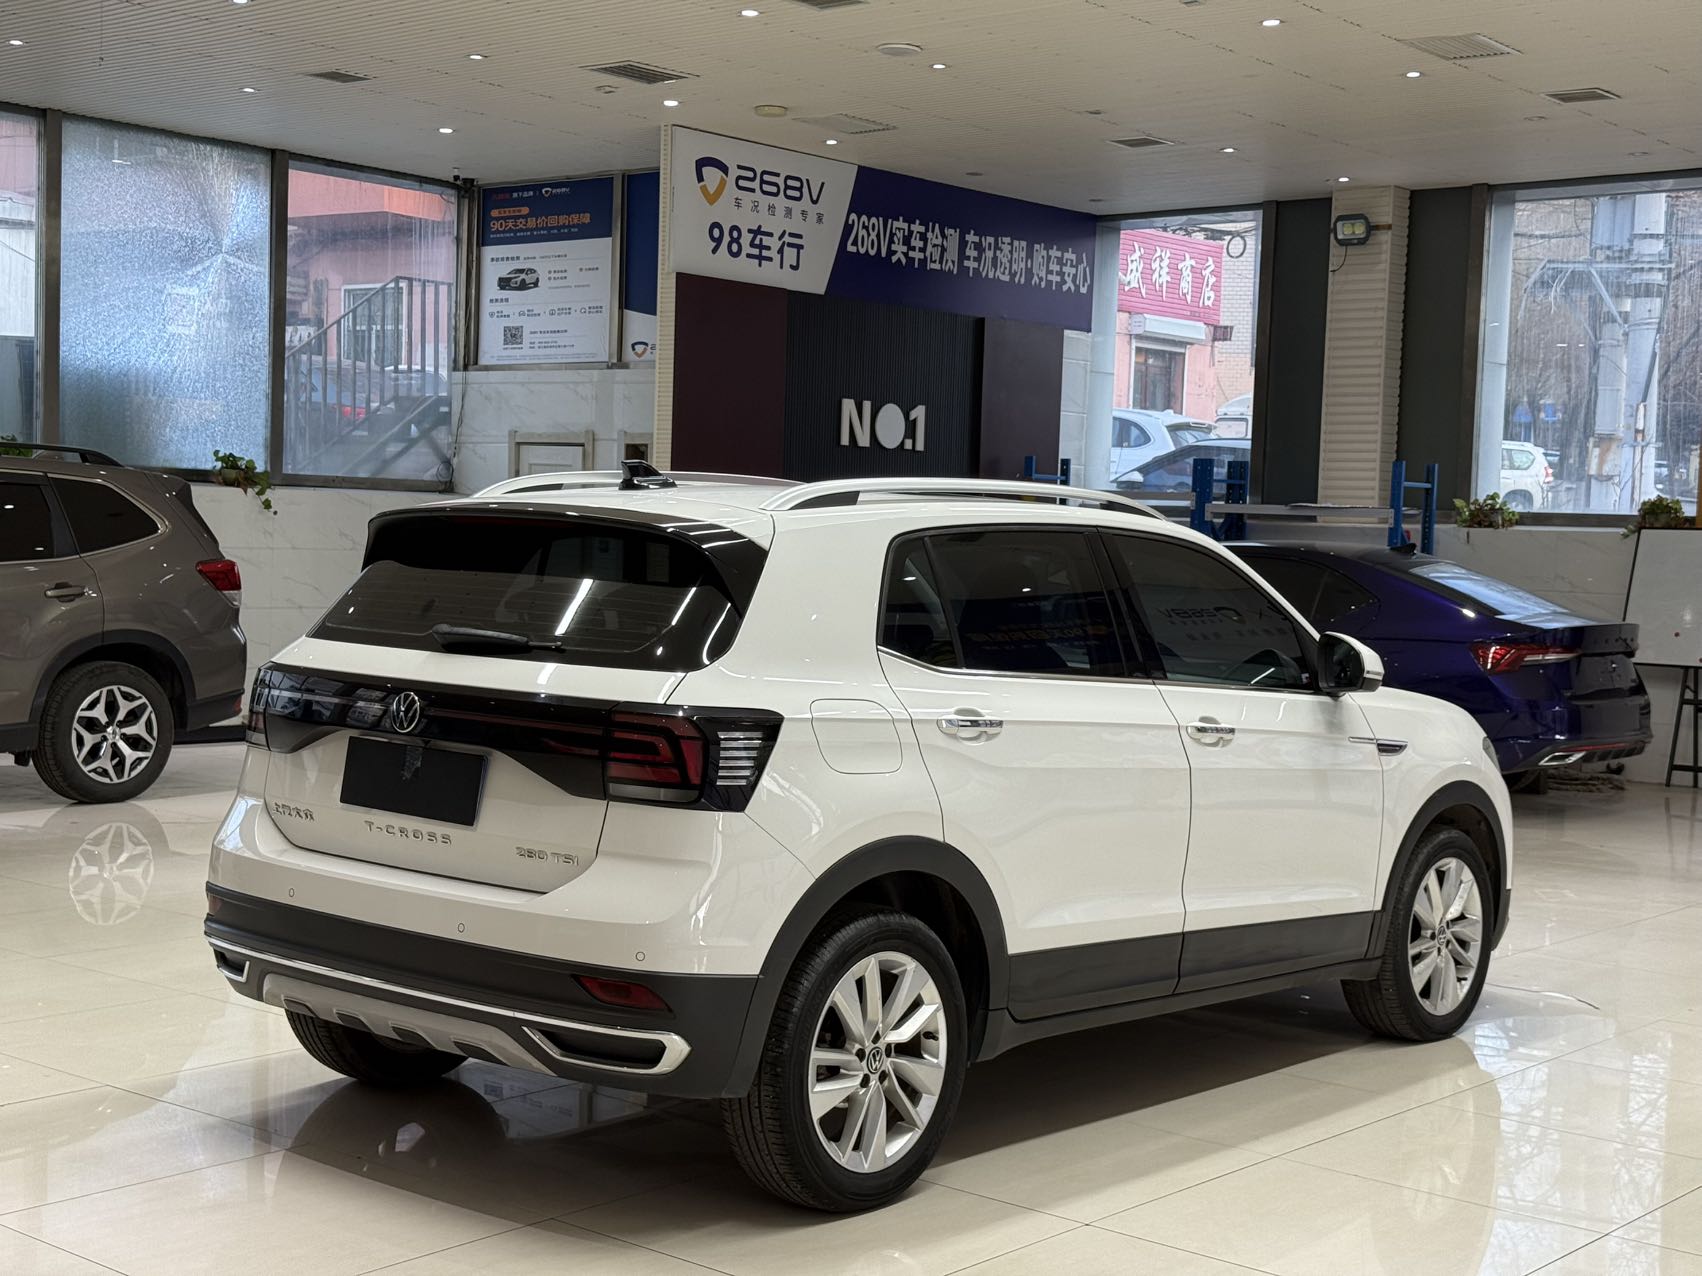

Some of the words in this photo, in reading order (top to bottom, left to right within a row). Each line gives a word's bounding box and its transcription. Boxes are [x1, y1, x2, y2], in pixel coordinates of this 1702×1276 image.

[734, 164, 825, 206] 268V
[490, 212, 591, 232] 90天交易价回购保障
[734, 197, 824, 225] 车况检测专家
[708, 221, 805, 272] 98车行
[847, 212, 960, 275] 268V实车检测
[963, 229, 1090, 294] 车况透明·购车安心
[840, 398, 926, 451] NO.1
[363, 820, 453, 846] T-CROSS
[550, 852, 579, 867] TSI
